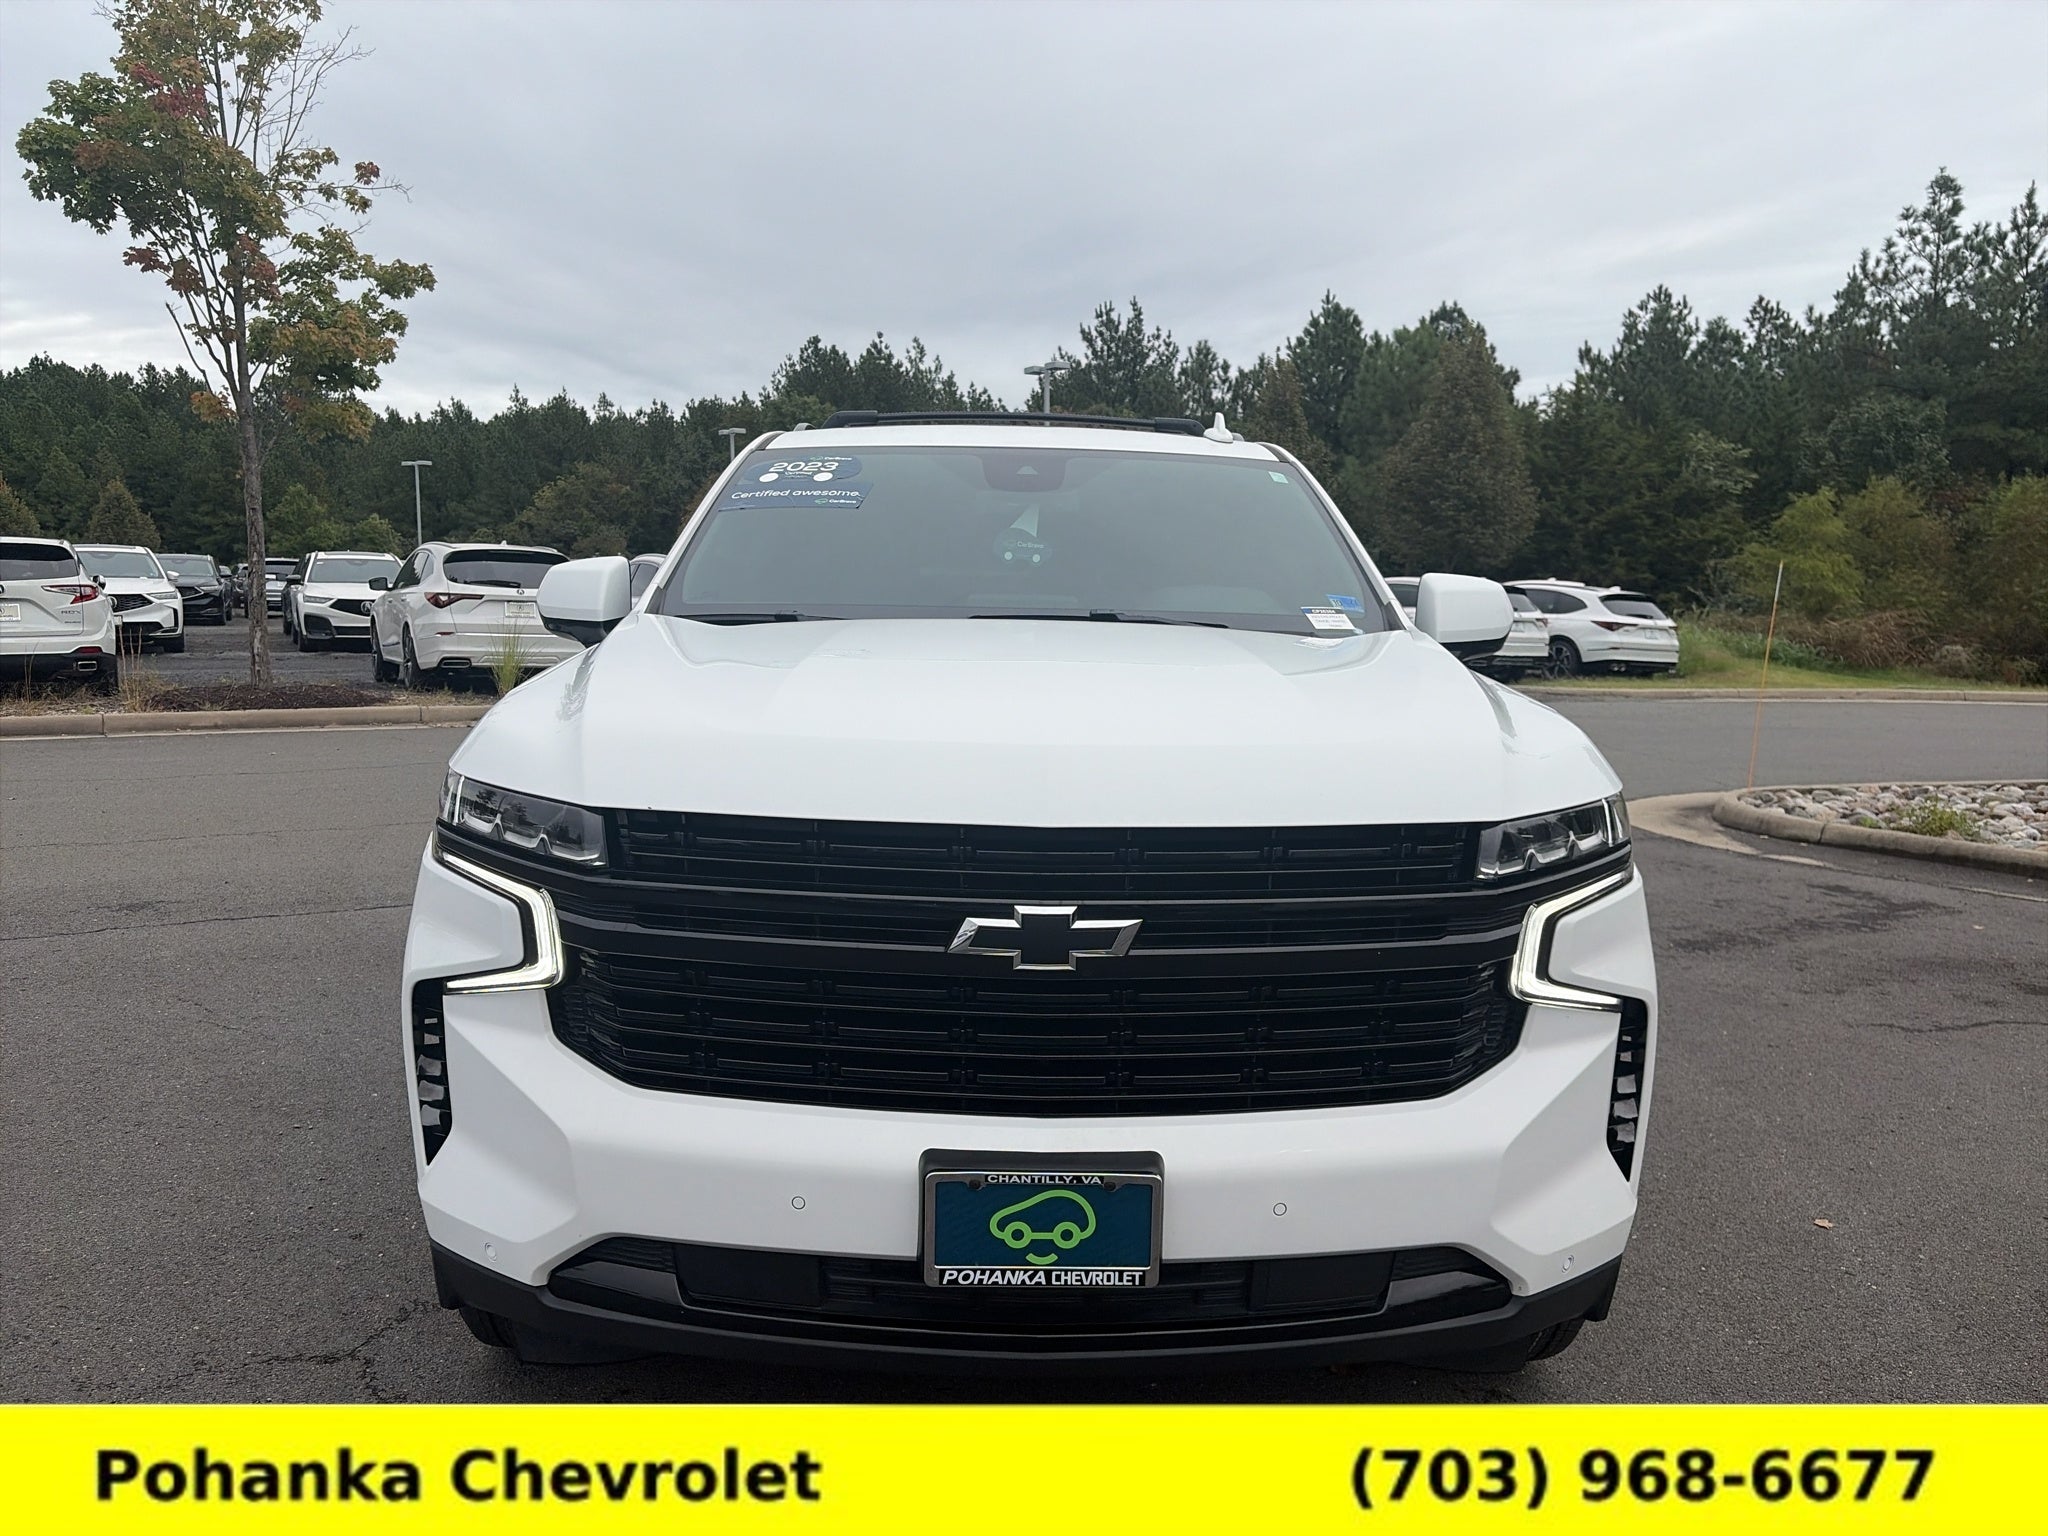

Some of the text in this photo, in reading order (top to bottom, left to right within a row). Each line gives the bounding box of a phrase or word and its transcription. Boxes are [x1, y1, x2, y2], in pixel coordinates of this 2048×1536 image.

[769, 461, 839, 472] 2023
[731, 489, 791, 499] Certified
[1081, 1176, 1101, 1185] VA
[942, 1269, 1143, 1286] POHANKA CHEVROLET
